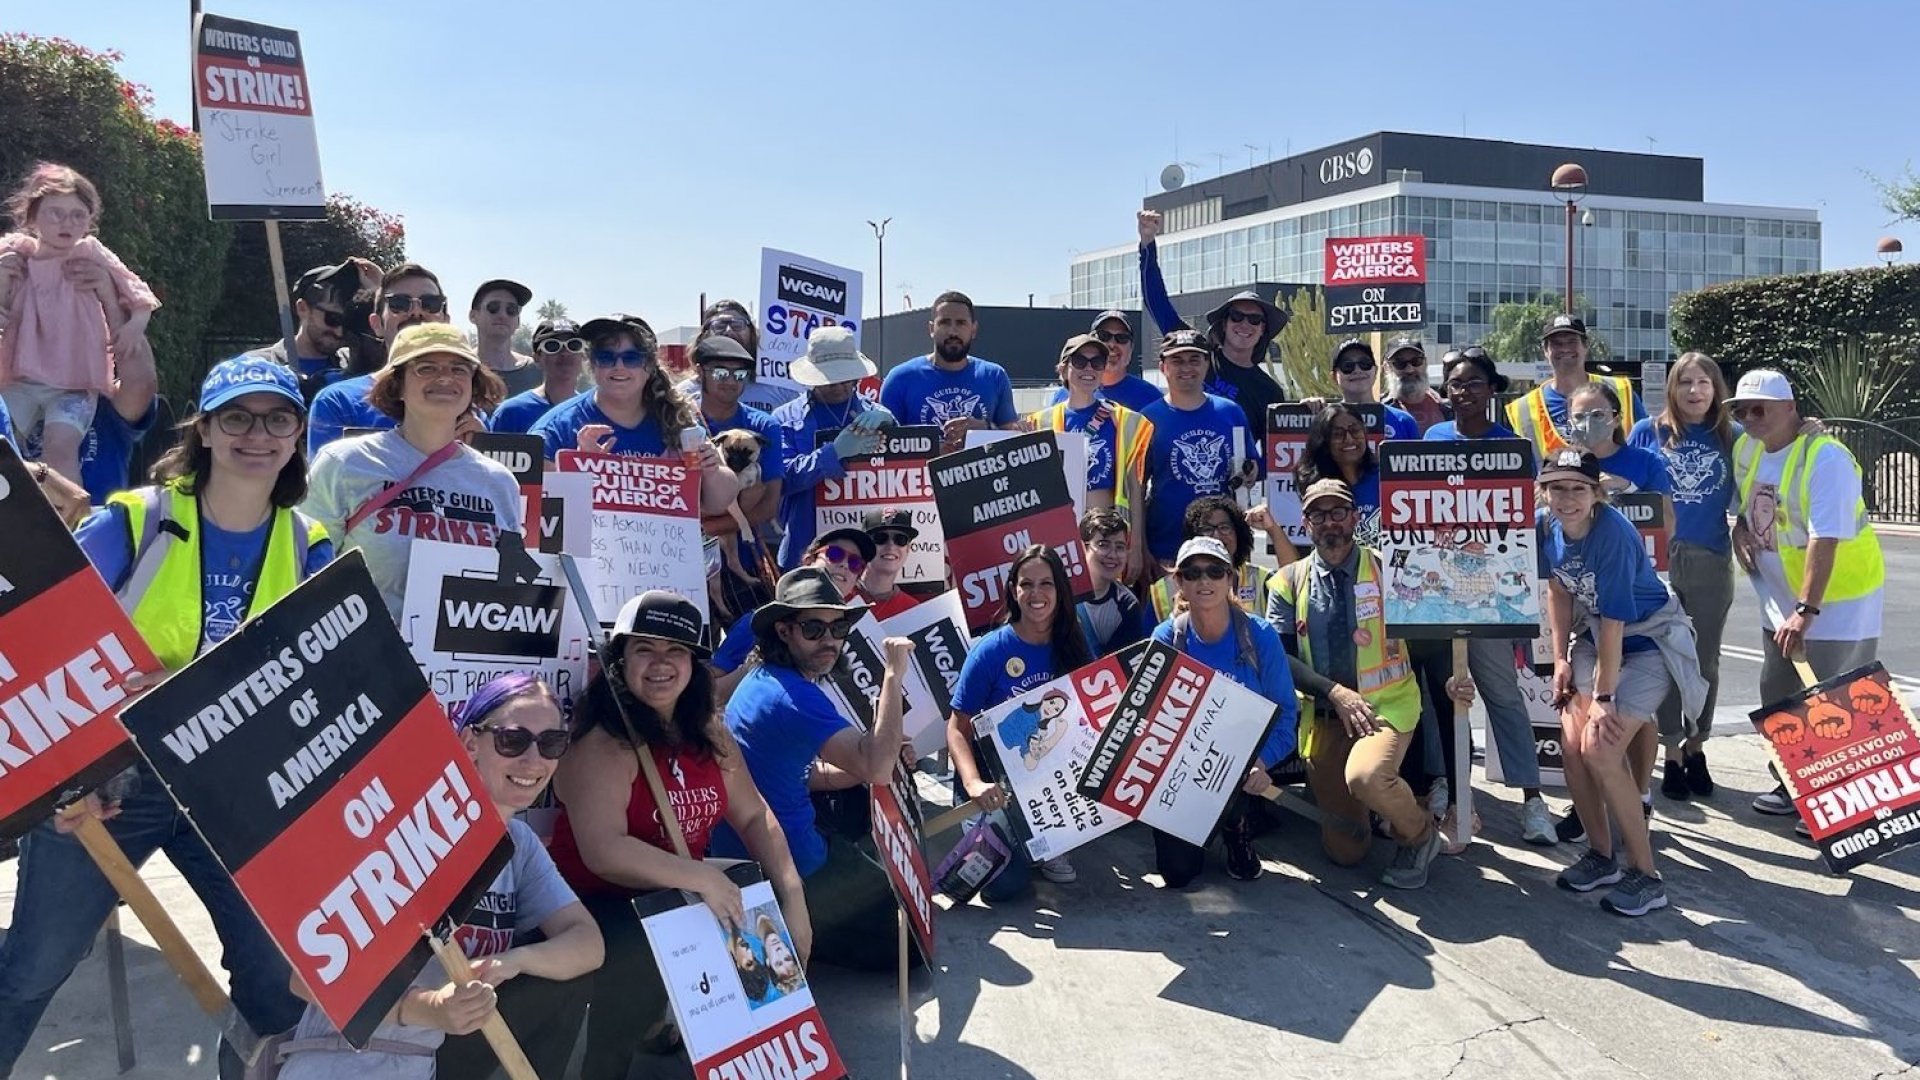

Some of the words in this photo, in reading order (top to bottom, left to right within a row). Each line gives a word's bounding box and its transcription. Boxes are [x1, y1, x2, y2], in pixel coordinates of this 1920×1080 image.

[205, 28, 260, 52] WRITERS
[261, 38, 296, 59] GUILD
[248, 55, 260, 68] ON
[205, 66, 305, 110] STRIKE!
[251, 144, 281, 166] Girl
[1320, 152, 1356, 184] CBS
[1332, 241, 1415, 257] WRITERS
[1336, 254, 1393, 269] GUILD
[1394, 256, 1413, 266] OF
[1331, 265, 1419, 280] AMERICA
[781, 276, 844, 303] WGAW
[1362, 288, 1386, 303] ON
[1330, 303, 1422, 328] STRIKE
[1275, 414, 1313, 428] WRIT
[889, 437, 932, 454] GUILD
[484, 451, 532, 473] ILD
[573, 457, 687, 482] WRITERS
[870, 457, 885, 467] ON
[937, 453, 1007, 487] WRITERS
[1007, 442, 1053, 469] GUILD
[1389, 453, 1468, 472] WRITERS
[1470, 453, 1523, 471] GUILD
[657, 484, 681, 495] OF
[824, 466, 934, 501] STRIKE!
[993, 476, 1009, 493] OF
[1447, 474, 1464, 486] ON
[450, 492, 494, 513] GUILD
[593, 489, 689, 511] MERICA
[972, 488, 1041, 523] AMERICA
[1391, 486, 1525, 524] STRIKE!
[613, 514, 656, 537] ASKING
[664, 523, 687, 544] FOR
[1003, 528, 1031, 555] ON
[620, 536, 652, 555] THAN
[661, 541, 687, 564] ONE
[628, 563, 670, 578] NEWS
[902, 563, 925, 580] LA
[444, 598, 559, 635] WGAW
[843, 641, 881, 706] WGA
[925, 626, 960, 696] WGA
[162, 646, 304, 765] WRITERS
[298, 594, 368, 664] GUILD
[289, 688, 321, 728] OF
[1085, 707, 1138, 789] WRITERS
[1130, 651, 1166, 708] GUILD
[1114, 665, 1206, 807] STRIKE!
[1133, 717, 1149, 737] ON
[1885, 730, 1908, 745] 100
[267, 693, 383, 809] AMERICA
[1159, 755, 1192, 811] BEST
[1194, 695, 1227, 743] FINAL
[1848, 738, 1885, 759] DAYS
[1882, 746, 1906, 760] 100
[1193, 741, 1220, 789] NOT
[1797, 751, 1848, 779] STRONG
[1845, 754, 1882, 774] DAYS
[1809, 768, 1845, 789] LONG
[668, 786, 719, 805] RITERS
[1054, 769, 1067, 790] on
[1063, 792, 1087, 832] dicks
[1805, 757, 1920, 830] STRIKE!
[345, 776, 396, 839] ON
[1027, 799, 1053, 833] day!
[1042, 786, 1066, 830] every
[1874, 806, 1893, 820] ON
[1830, 828, 1880, 859] GUILD
[297, 760, 482, 985] STRIKE!
